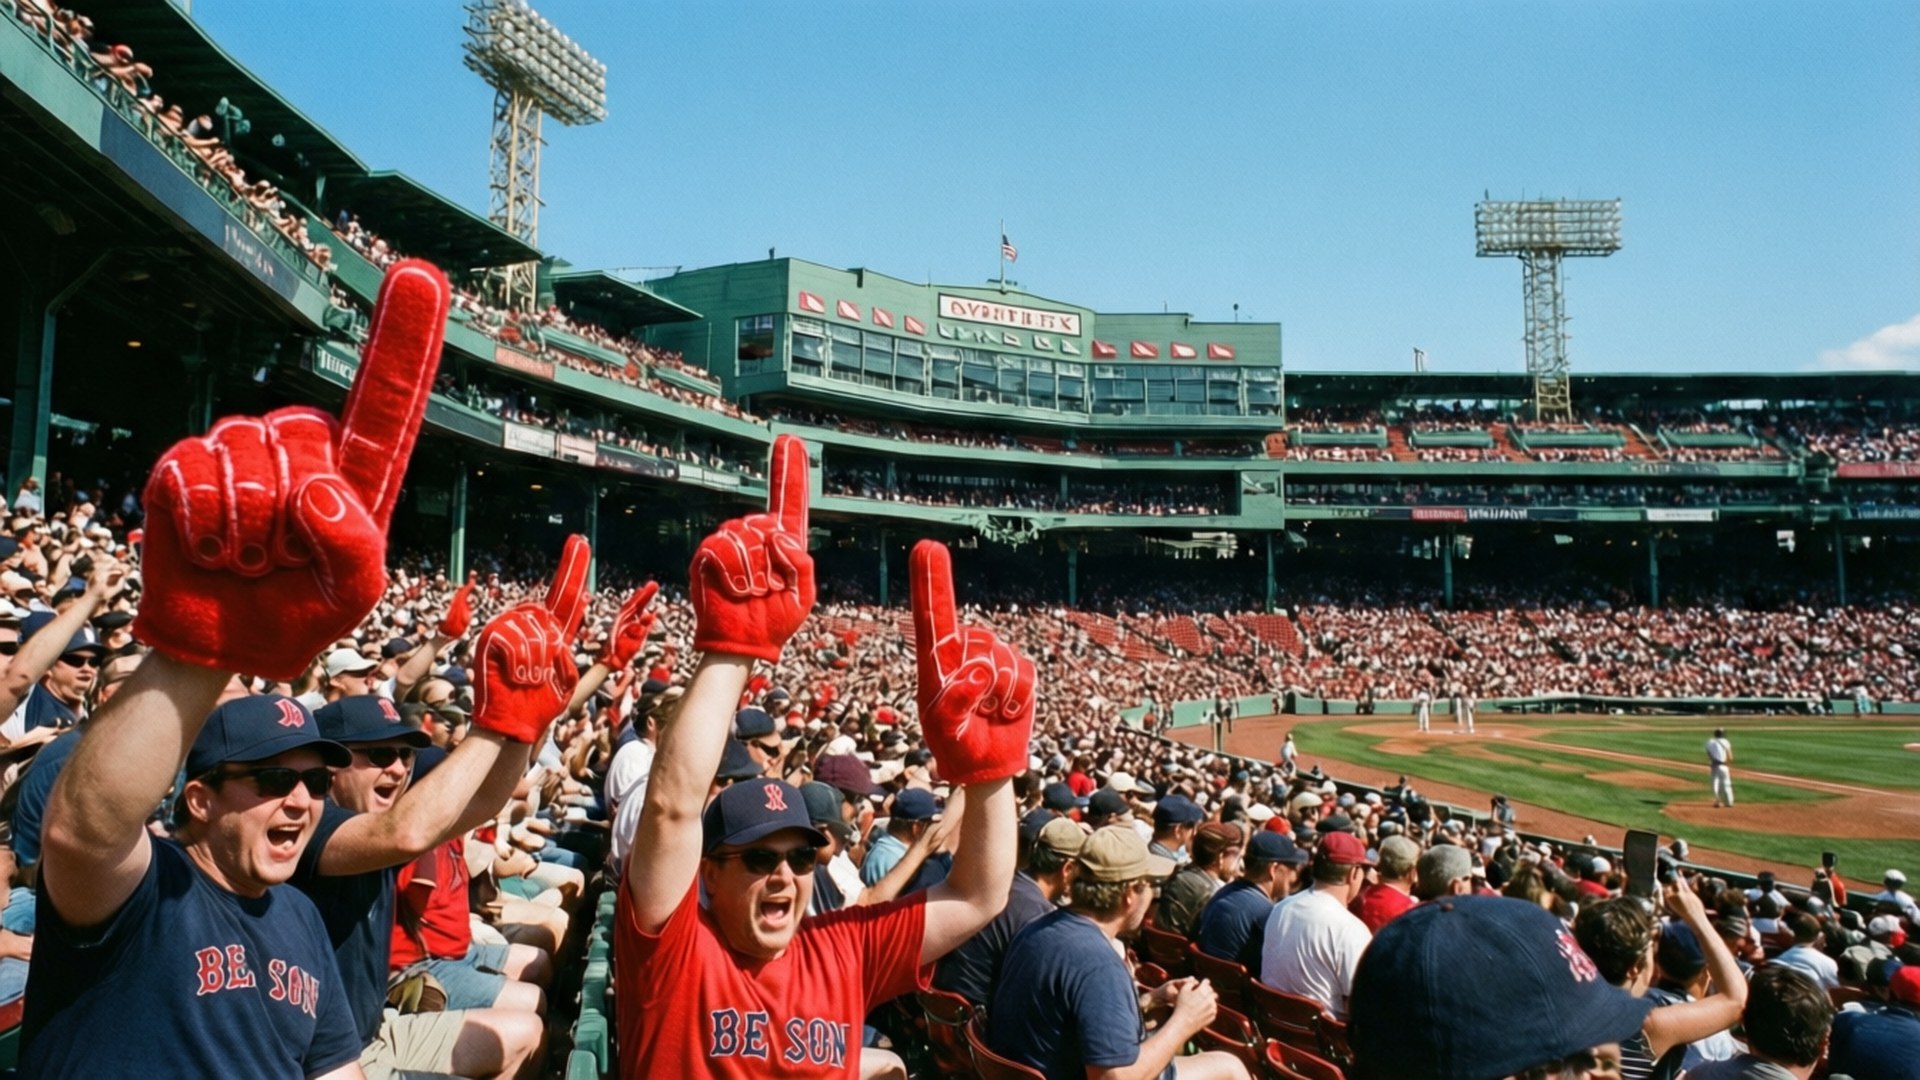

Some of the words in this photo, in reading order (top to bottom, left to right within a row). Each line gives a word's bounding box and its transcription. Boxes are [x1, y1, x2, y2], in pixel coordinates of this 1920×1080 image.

[195, 944, 256, 996] BE
[709, 1007, 769, 1062] BE
[784, 1017, 850, 1069] SON
